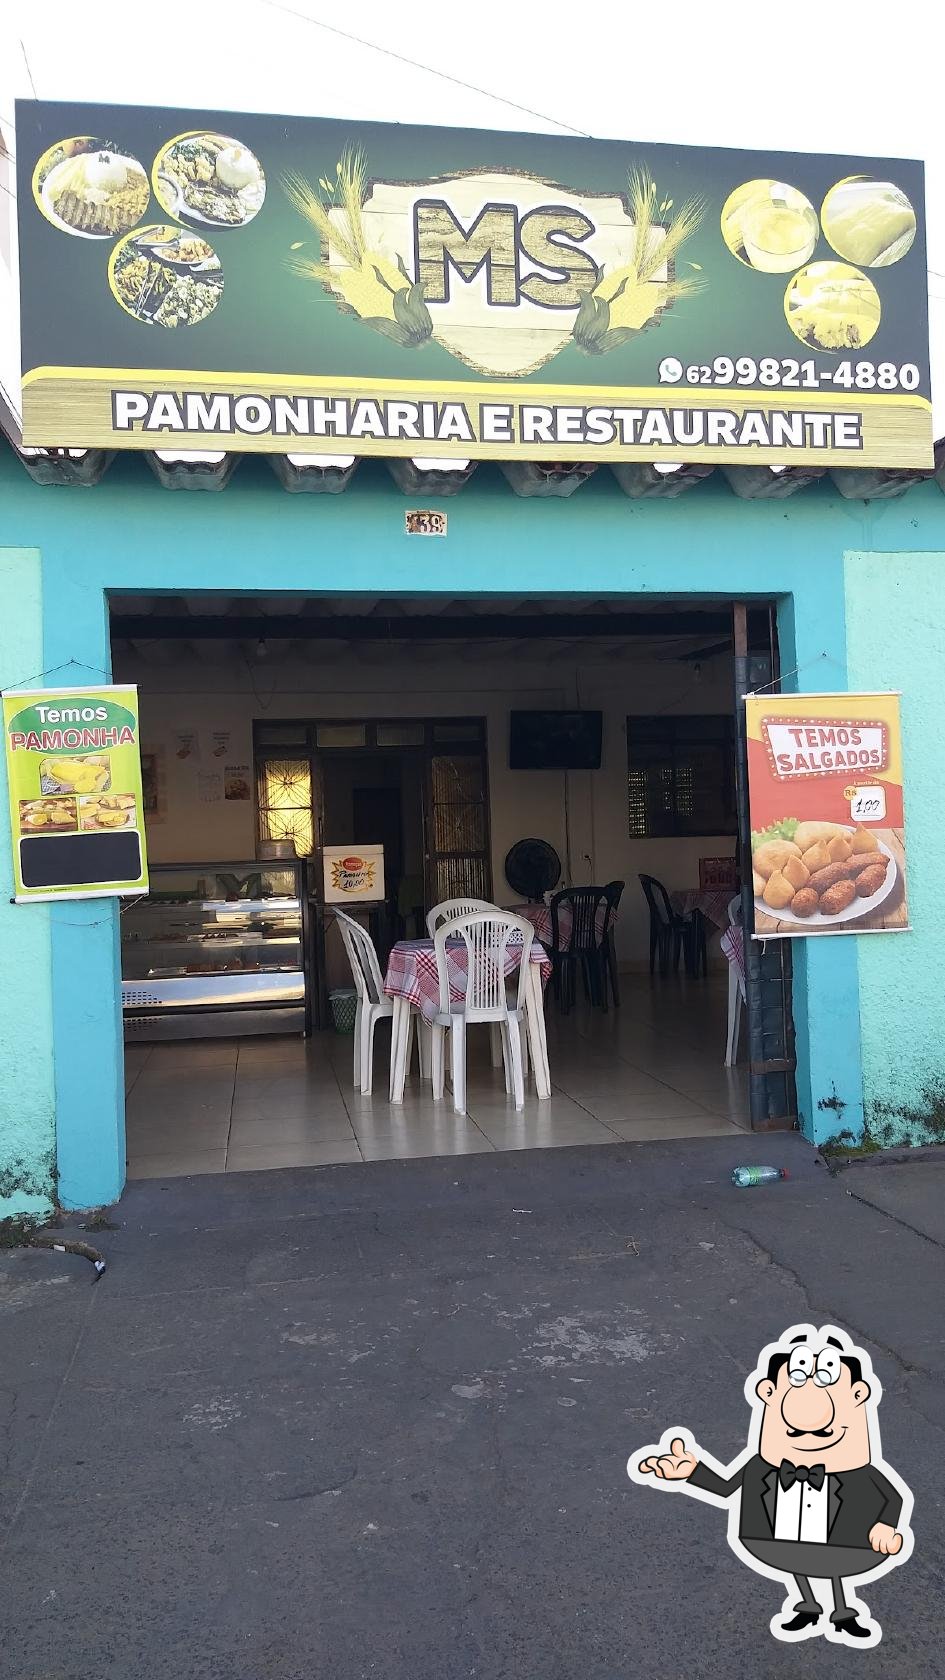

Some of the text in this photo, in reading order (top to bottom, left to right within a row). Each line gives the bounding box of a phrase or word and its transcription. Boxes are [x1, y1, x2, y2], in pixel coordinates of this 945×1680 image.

[414, 199, 599, 310] MS
[713, 356, 920, 391] 99821-4880
[113, 390, 863, 450] PAMONHARIA E RESTAURANTE
[35, 706, 108, 723] Temos
[10, 726, 136, 752] PAMONHA
[788, 728, 862, 748] TEMOS
[776, 749, 880, 772] SALGADOS
[855, 798, 880, 813] 1,00
